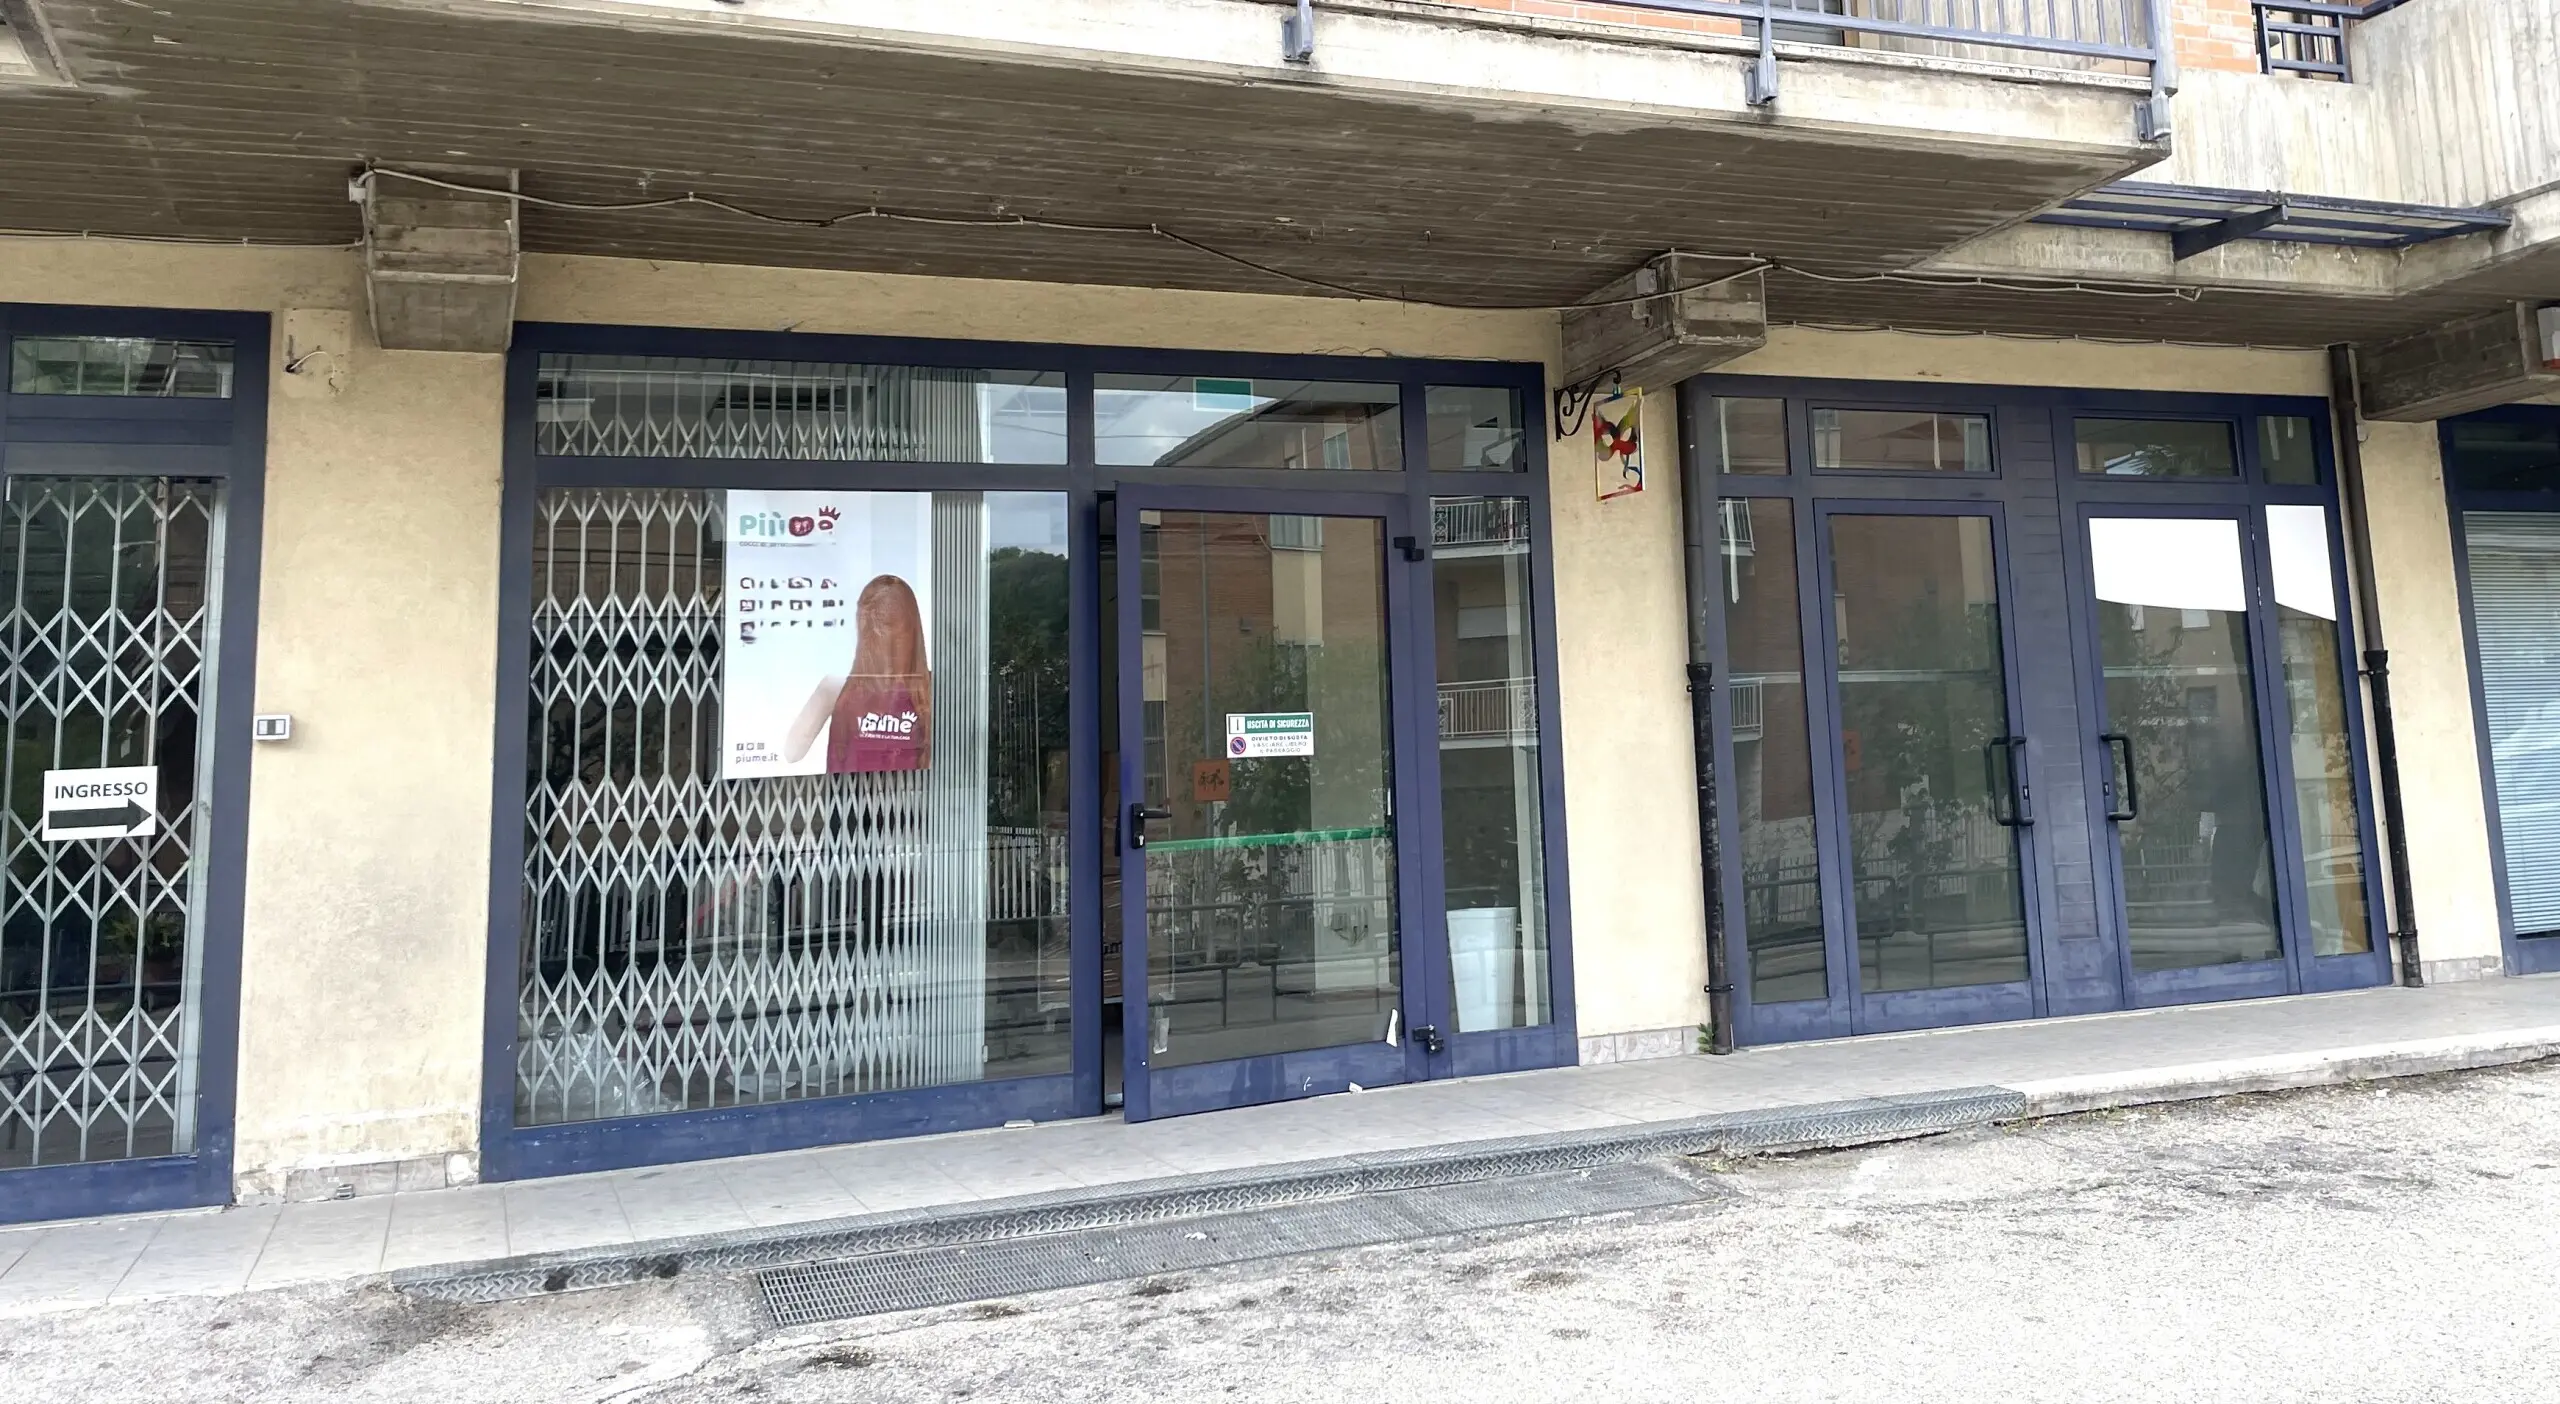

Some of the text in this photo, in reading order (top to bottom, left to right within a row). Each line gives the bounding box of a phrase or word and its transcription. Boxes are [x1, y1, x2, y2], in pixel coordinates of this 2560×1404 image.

[1246, 718, 1310, 729] USCITA DI SICUREZZA
[54, 781, 148, 799] INGRESSO
